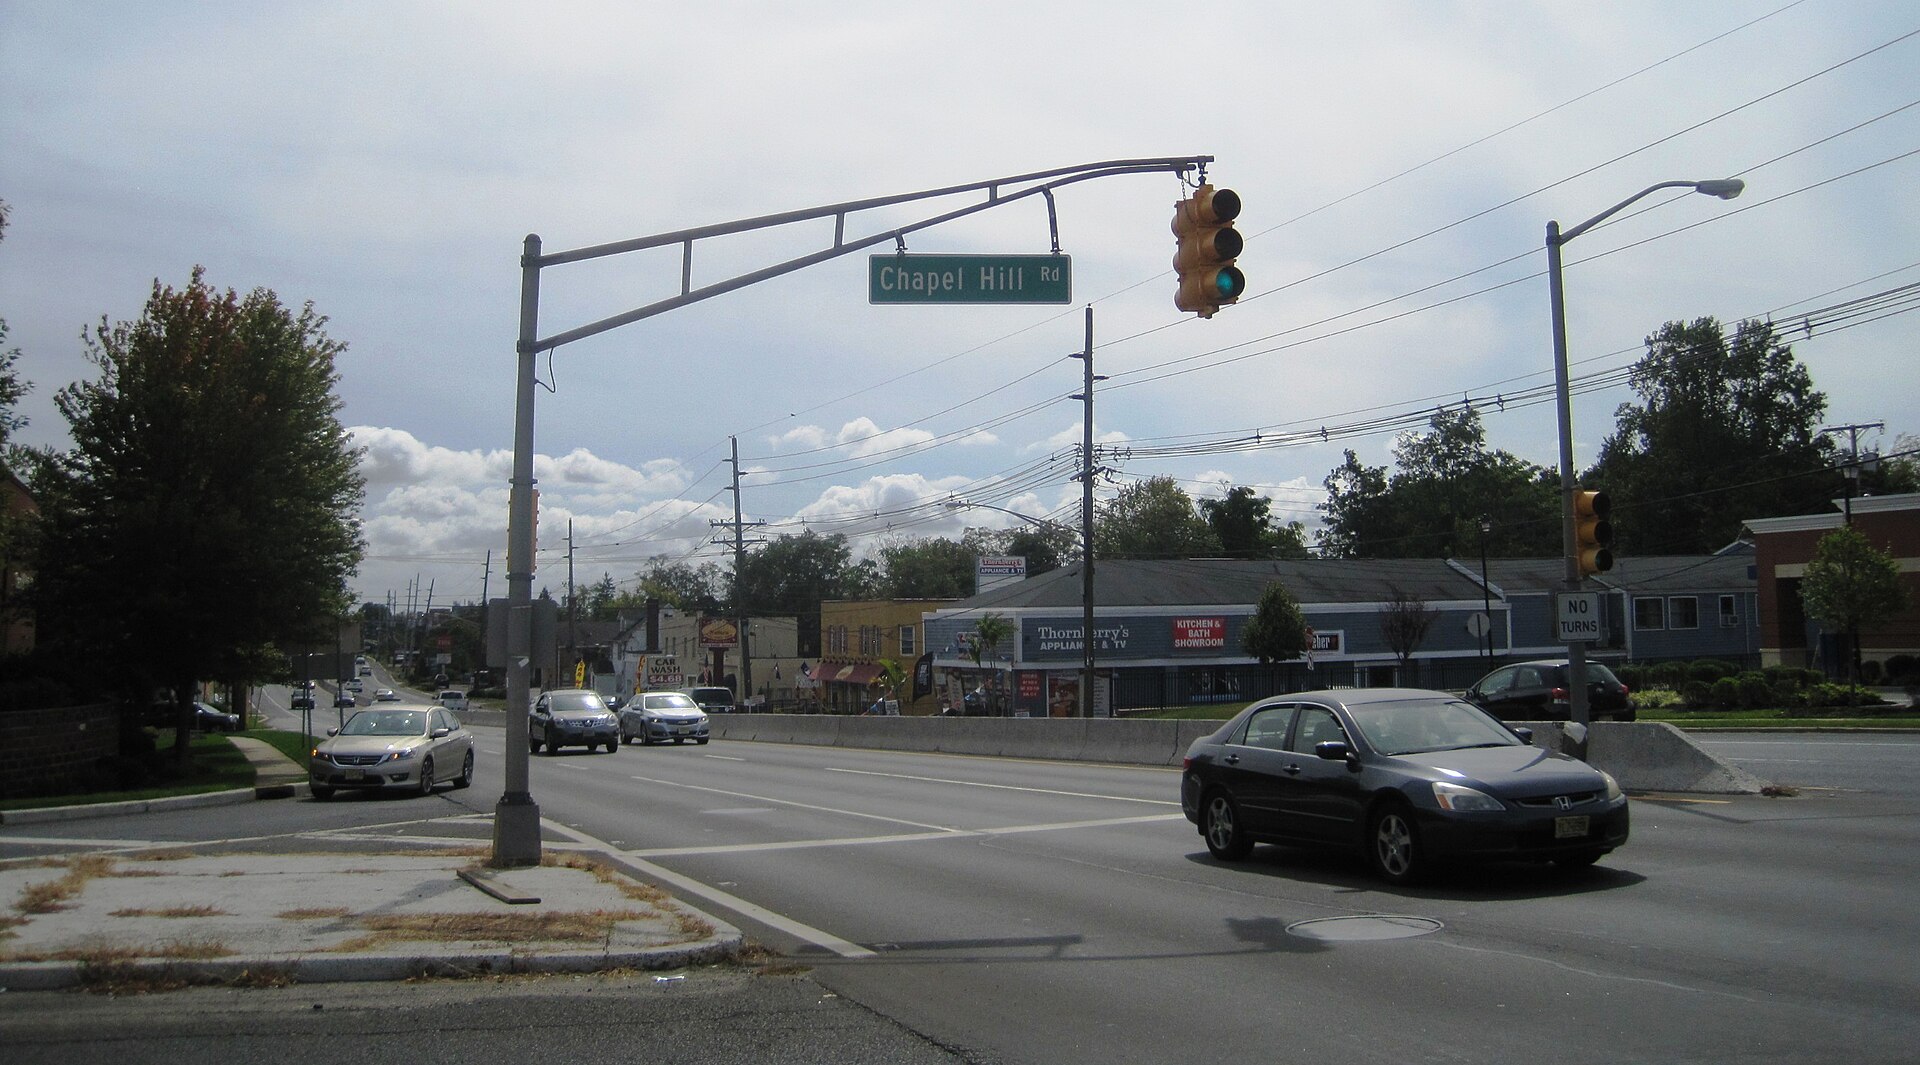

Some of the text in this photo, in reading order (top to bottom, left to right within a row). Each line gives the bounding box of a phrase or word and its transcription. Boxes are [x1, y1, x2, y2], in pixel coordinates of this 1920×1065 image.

[880, 266, 1060, 297] Chapel Hill Rd
[1568, 600, 1588, 613] NO
[1177, 619, 1220, 629] KITCHEN &
[1561, 620, 1597, 633] TURNS
[1038, 625, 1129, 641] Thornrry's
[1188, 628, 1210, 638] BATH
[1101, 640, 1108, 649] &
[1113, 640, 1126, 649] TV
[1174, 637, 1224, 648] SHOWROOM
[655, 658, 676, 666] CAR
[651, 665, 681, 674] WASH
